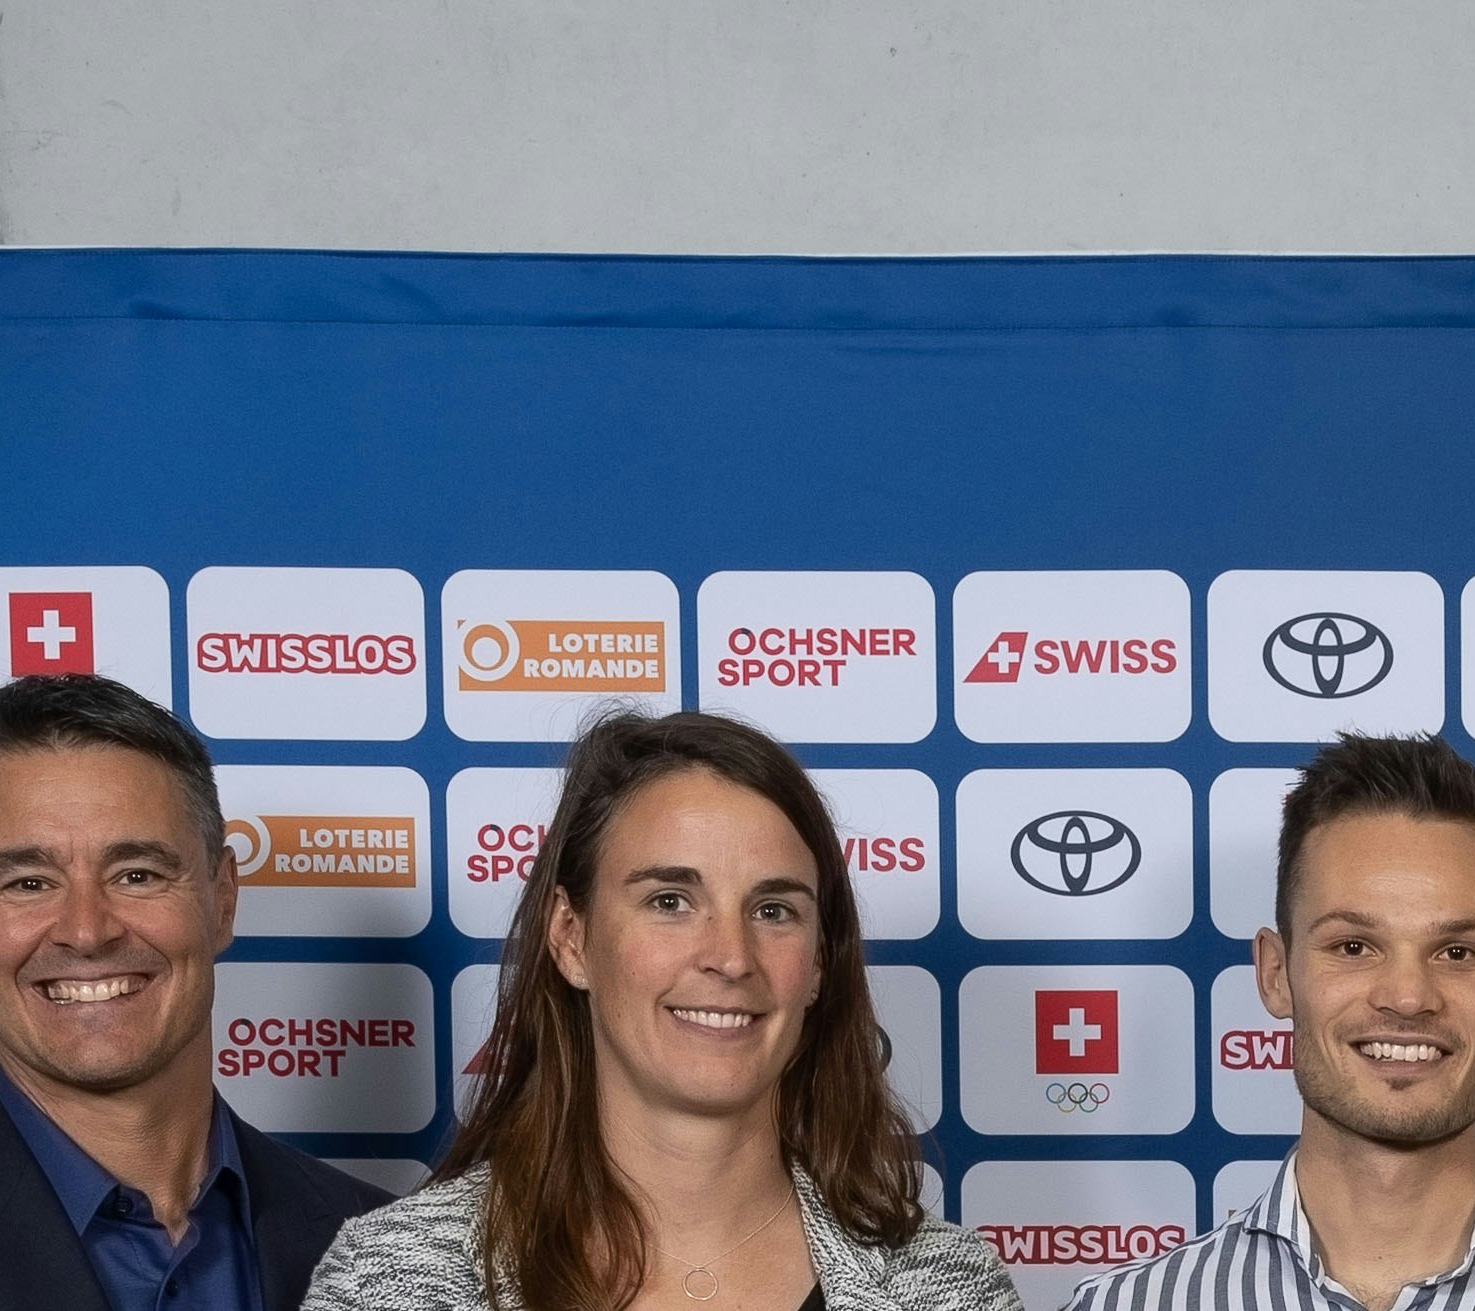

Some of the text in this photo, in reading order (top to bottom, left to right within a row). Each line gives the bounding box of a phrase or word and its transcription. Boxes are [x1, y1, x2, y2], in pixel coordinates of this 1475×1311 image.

[197, 633, 416, 675] SWISSLOS
[549, 634, 658, 652] LOTERIE
[729, 628, 916, 656] OCHSNER
[524, 659, 658, 678] ROMANDE
[1034, 639, 1176, 674] SWISS
[718, 659, 846, 686] SPORT
[300, 829, 408, 848] LOTERIE
[276, 854, 409, 873] ROMANDE
[845, 837, 927, 873] ISS
[228, 1017, 416, 1048] OCHSNER
[218, 1049, 346, 1077] SPORT
